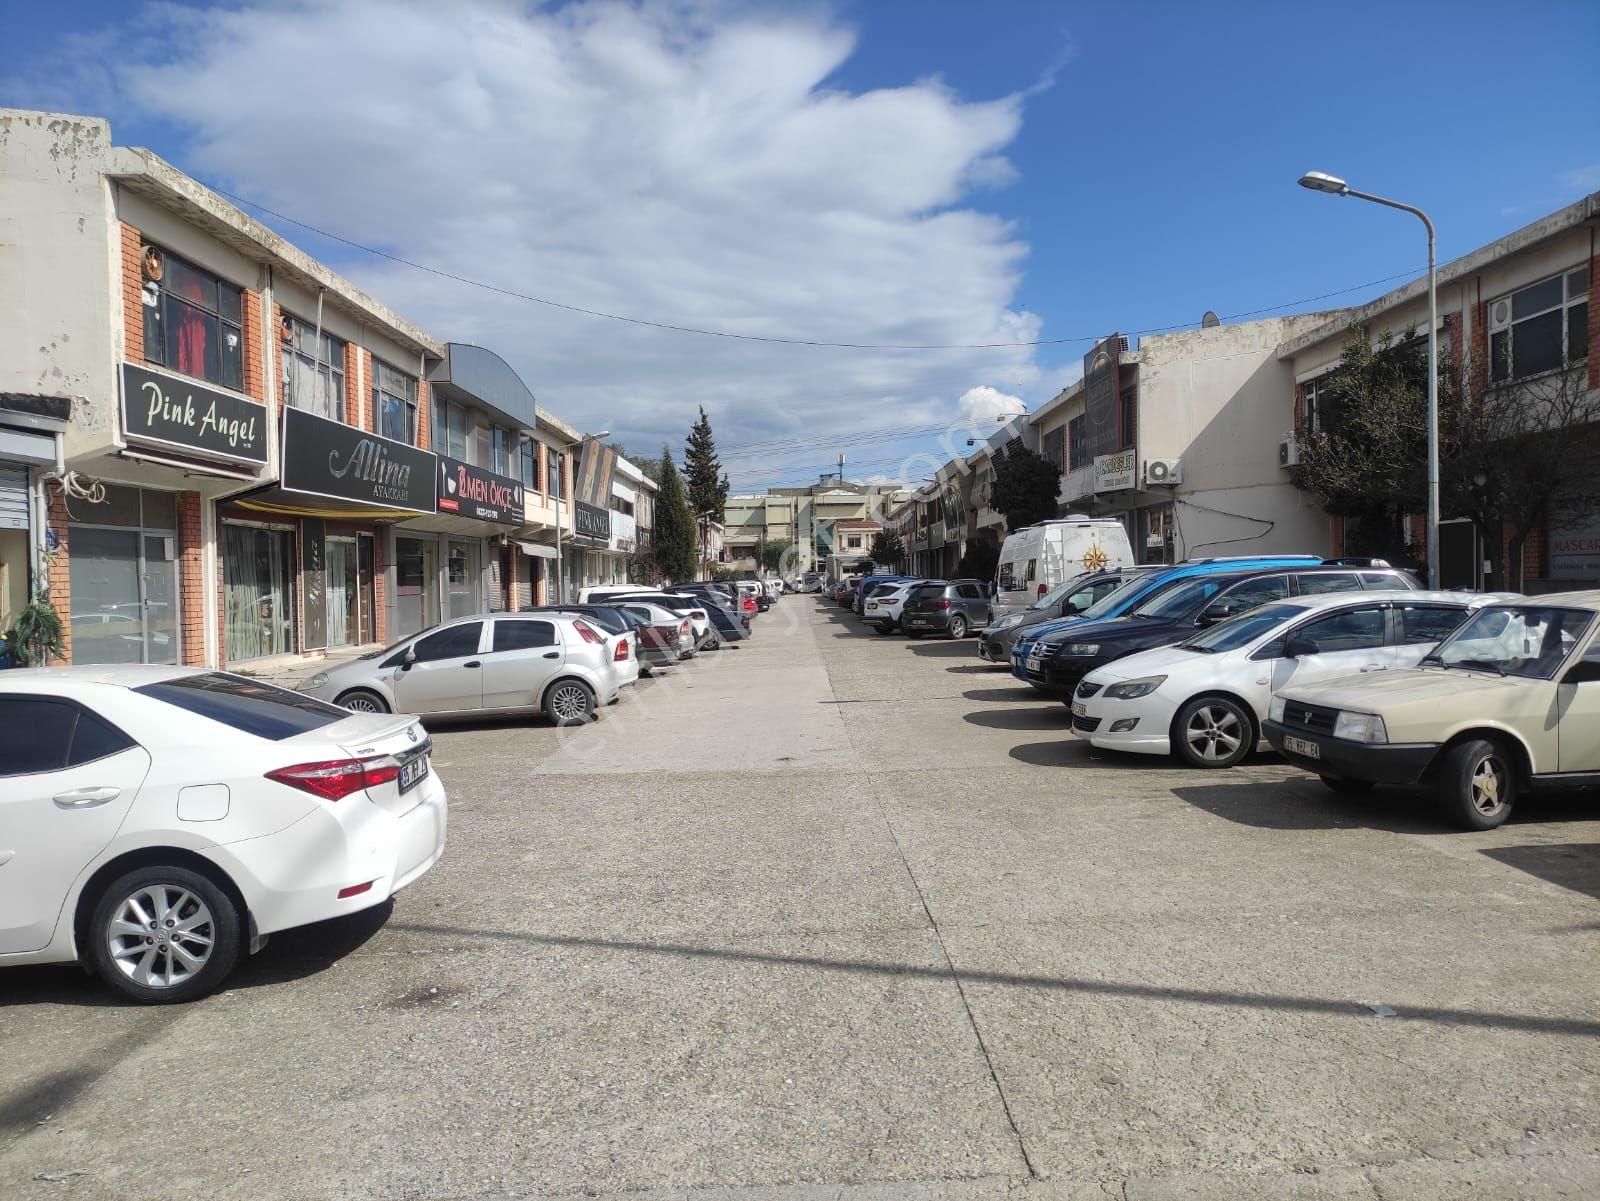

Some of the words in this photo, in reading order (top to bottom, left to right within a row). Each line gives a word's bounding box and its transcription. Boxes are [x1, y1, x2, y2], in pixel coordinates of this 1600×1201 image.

[141, 381, 196, 427] Pink
[199, 400, 256, 448] Angel
[328, 438, 411, 488] Allina
